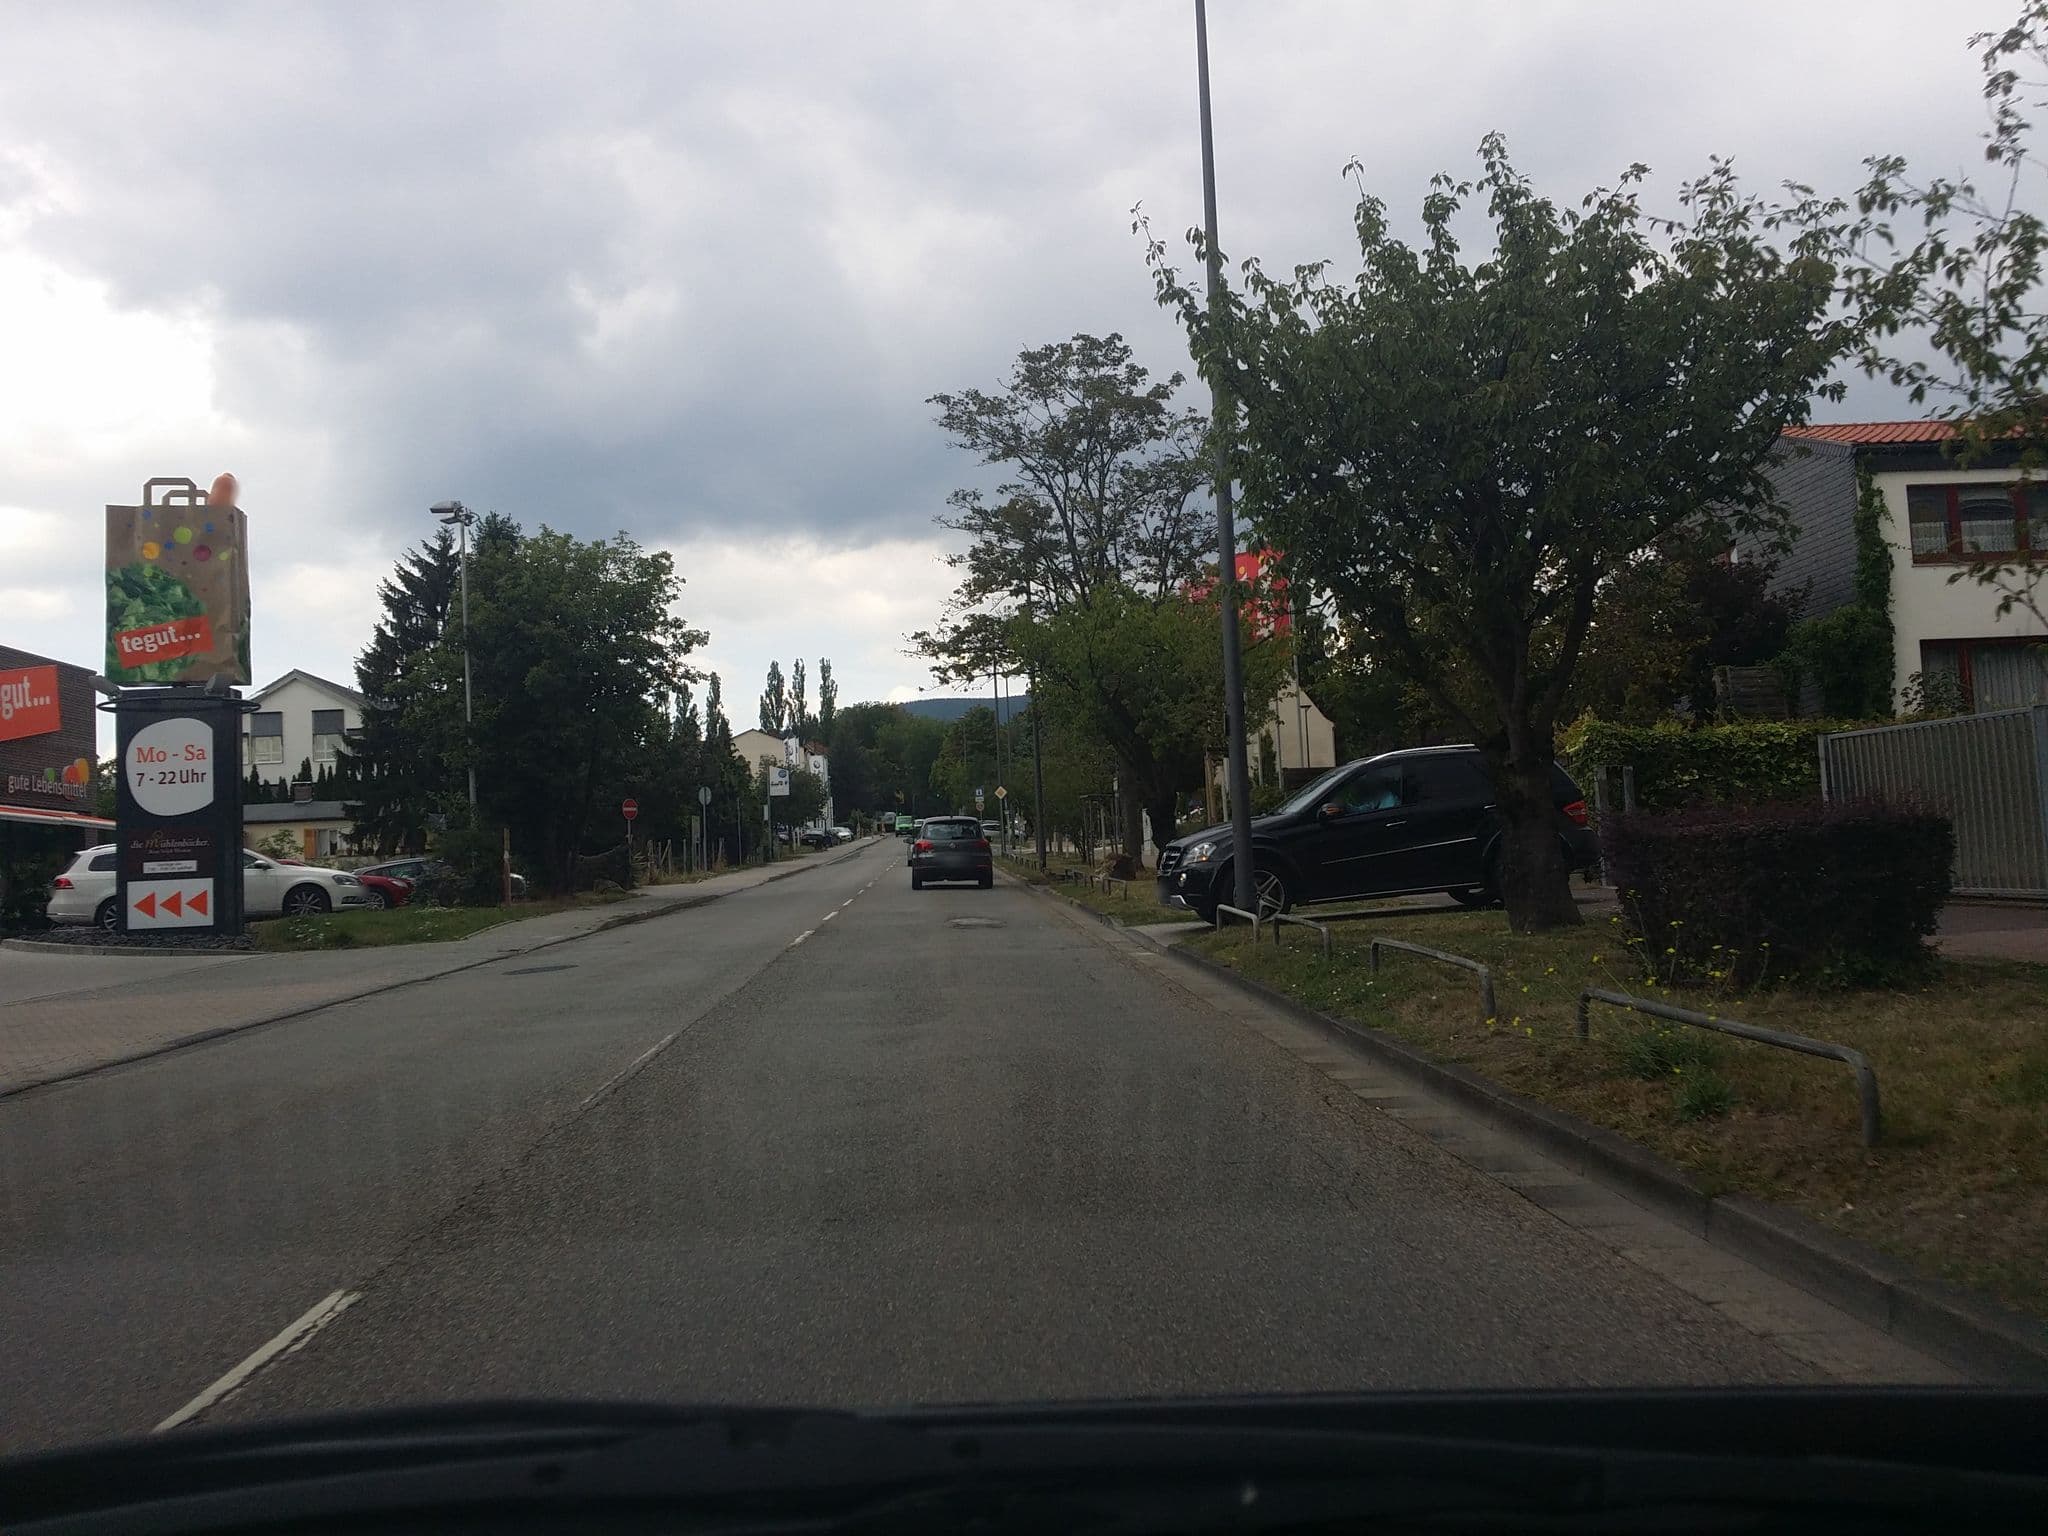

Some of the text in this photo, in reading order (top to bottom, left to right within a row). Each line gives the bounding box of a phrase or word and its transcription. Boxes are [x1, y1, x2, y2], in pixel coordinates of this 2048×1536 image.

[121, 626, 201, 653] tegut...
[0, 675, 51, 720] gut...
[136, 746, 167, 763] Mo
[184, 744, 207, 761] Sa
[8, 774, 87, 798] gute Lebensmittel
[136, 772, 145, 787] 7
[158, 771, 176, 785] 22
[180, 768, 207, 784] Uhr
